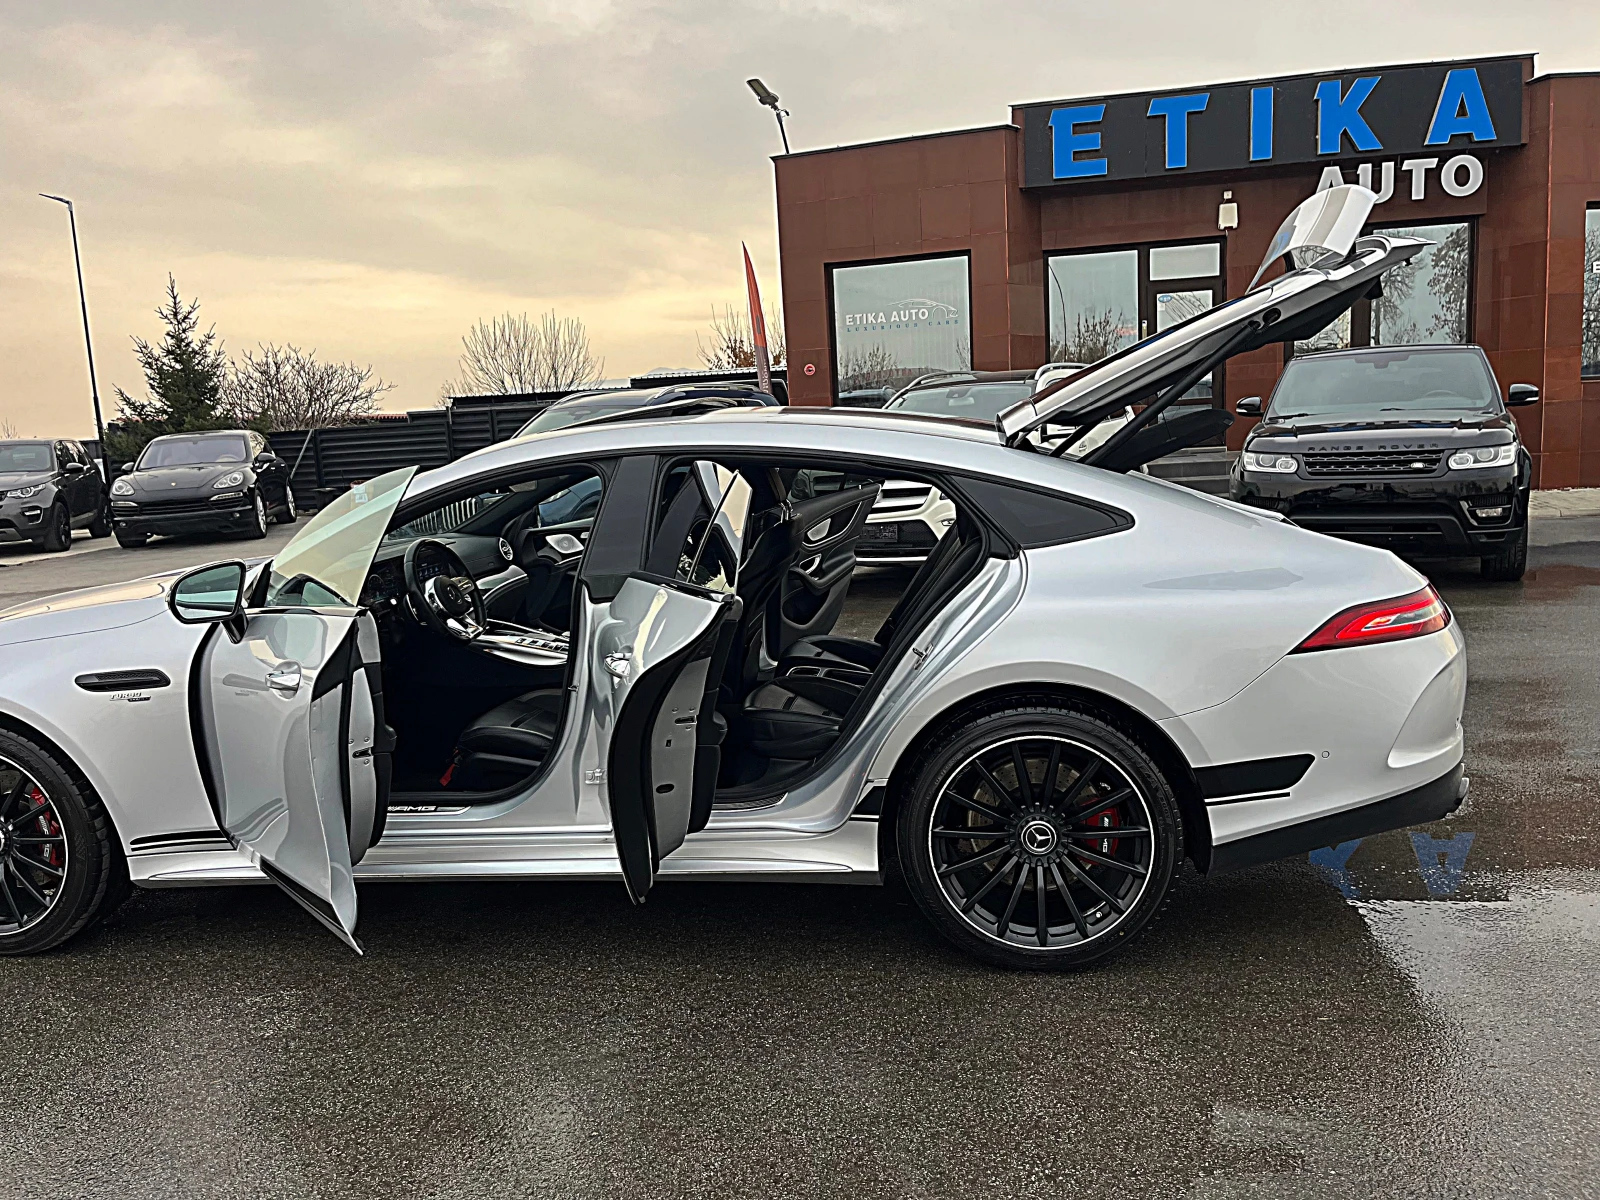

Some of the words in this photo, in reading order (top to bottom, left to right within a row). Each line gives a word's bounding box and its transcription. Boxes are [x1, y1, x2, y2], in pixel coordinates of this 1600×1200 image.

[1048, 67, 1497, 179] ETIKA
[1315, 154, 1484, 204] AUTO
[845, 312, 887, 326] ETIKA
[890, 308, 929, 322] AUTO
[846, 322, 918, 333] LUXURIOUS
[928, 319, 959, 327] CARS
[1378, 443, 1439, 451] ROVER
